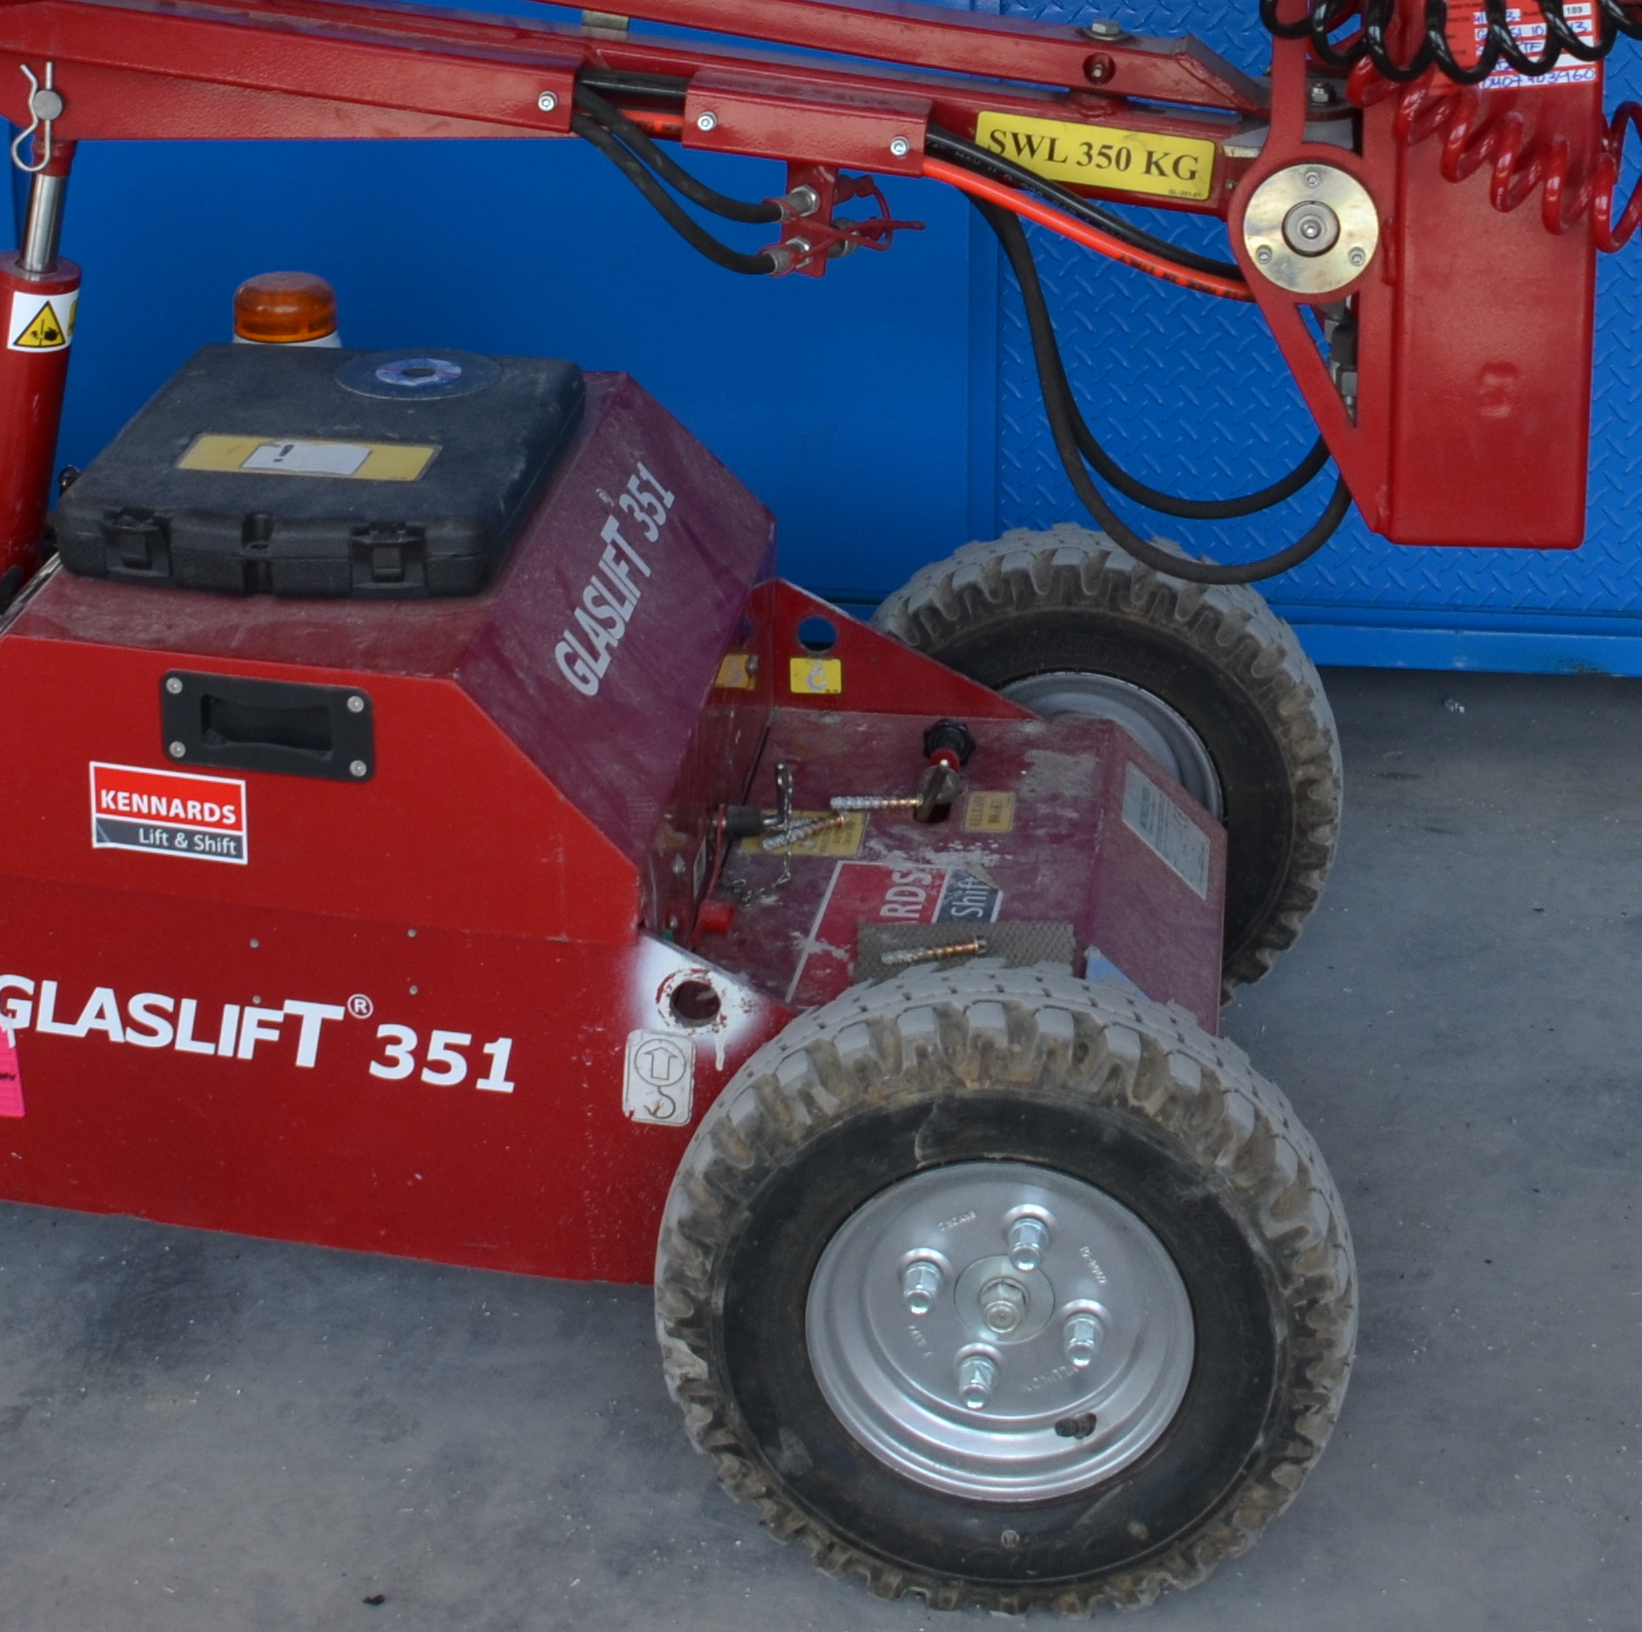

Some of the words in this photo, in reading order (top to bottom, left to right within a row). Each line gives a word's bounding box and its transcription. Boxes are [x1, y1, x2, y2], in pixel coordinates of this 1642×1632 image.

[987, 128, 1069, 164] SWL
[1075, 142, 1133, 172] 350
[1141, 149, 1199, 181] KG
[554, 514, 652, 697] GLASLIFT
[618, 461, 676, 543] 351
[100, 789, 237, 825] KENNARDS
[138, 827, 169, 847] Lift
[174, 832, 189, 849] &
[193, 834, 238, 855] Shift
[369, 1023, 515, 1094] 351
